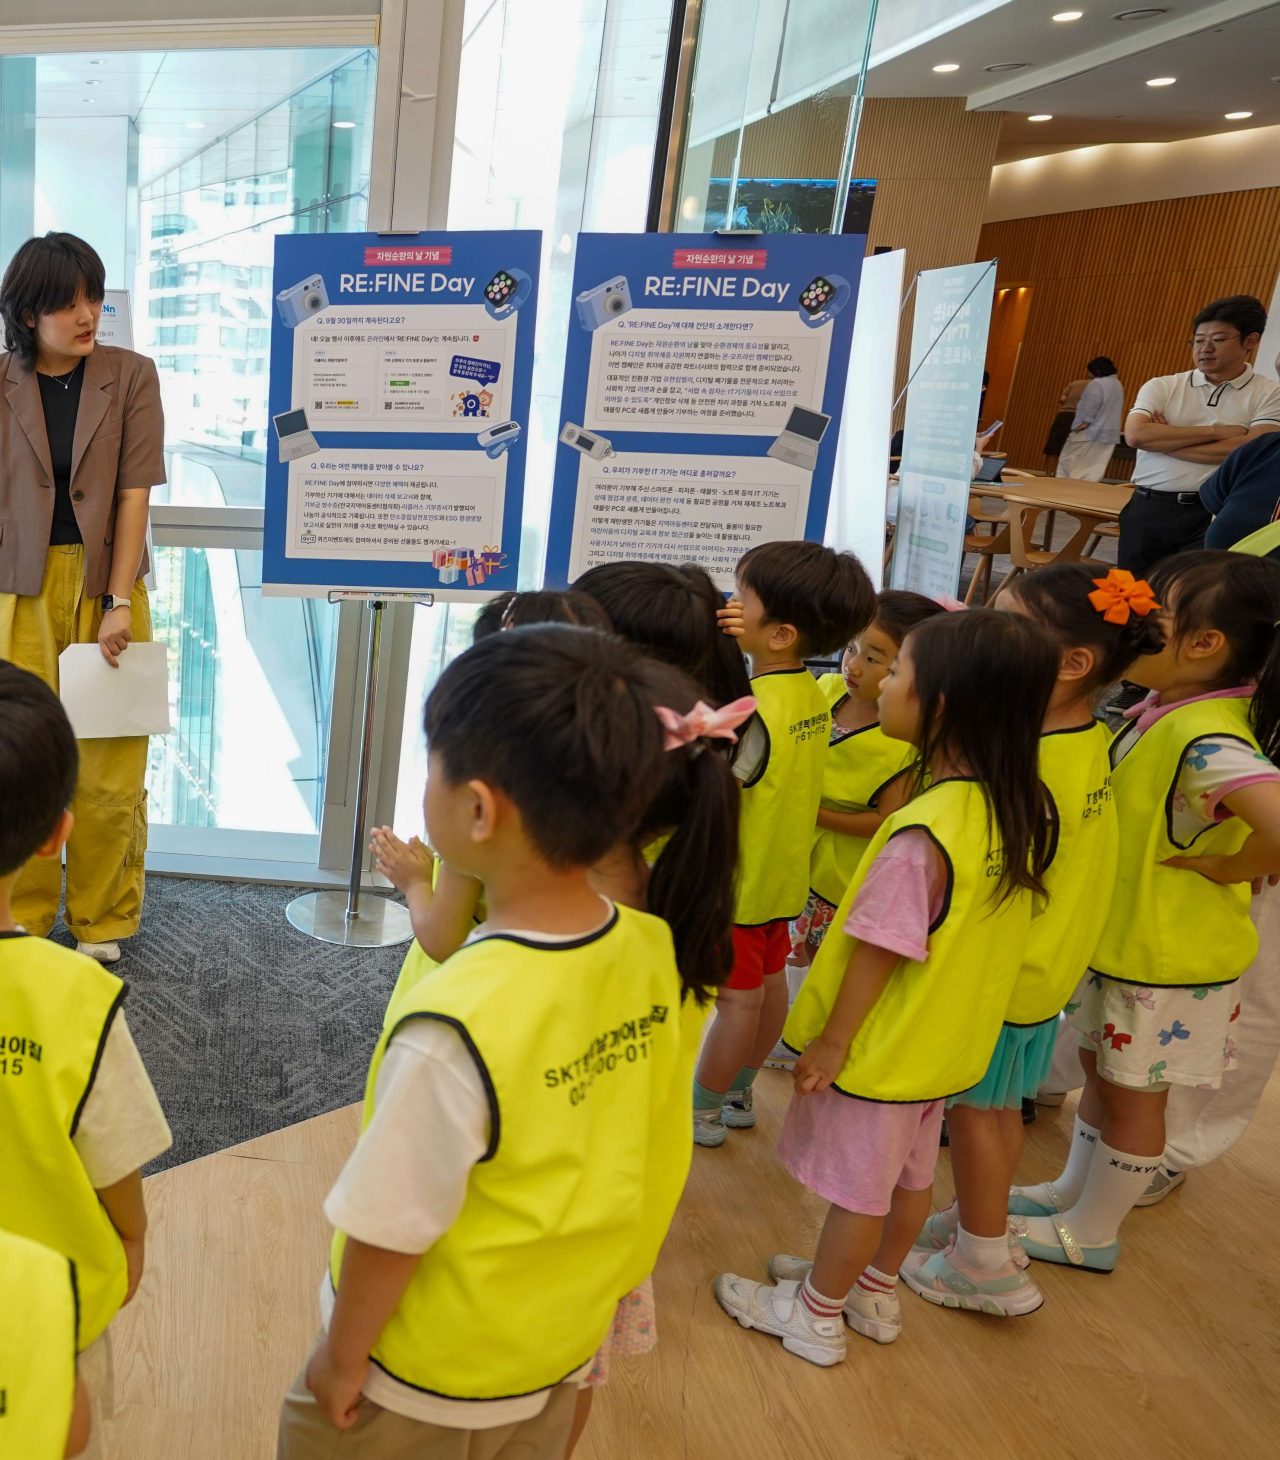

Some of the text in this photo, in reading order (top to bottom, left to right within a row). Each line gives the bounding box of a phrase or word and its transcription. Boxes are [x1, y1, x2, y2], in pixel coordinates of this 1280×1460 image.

[376, 251, 439, 260] 자원순환의 날 기념
[686, 254, 753, 264] 자원순환의 날 기념
[339, 273, 474, 296] RE:FINE Day
[644, 276, 790, 302] RE:FINE Day
[716, 322, 753, 330] 소개한다면?
[659, 468, 678, 476] 기기는
[699, 470, 736, 478] 흘러갈까요?
